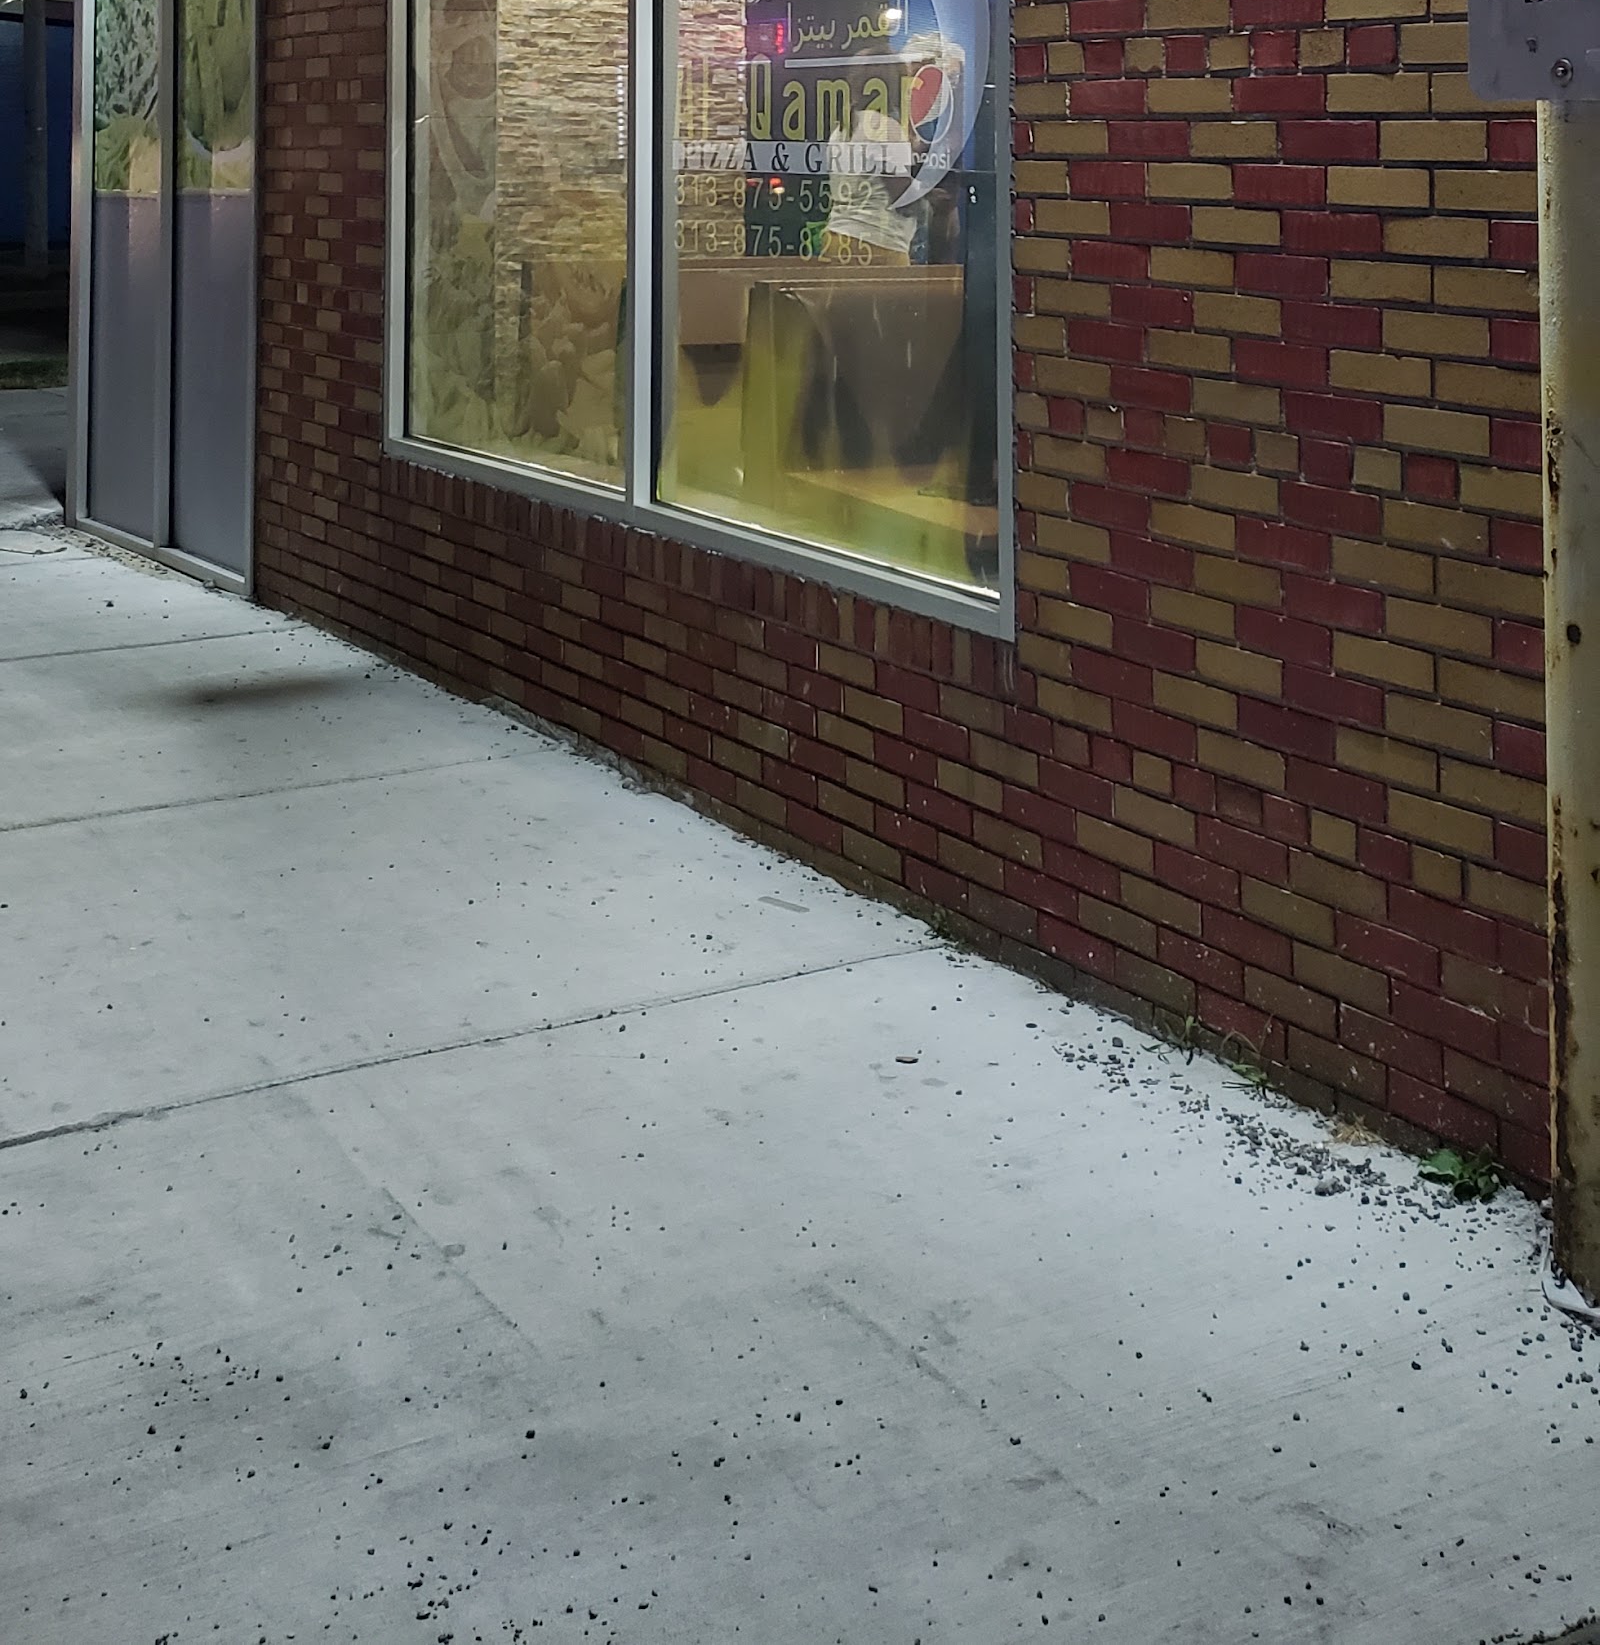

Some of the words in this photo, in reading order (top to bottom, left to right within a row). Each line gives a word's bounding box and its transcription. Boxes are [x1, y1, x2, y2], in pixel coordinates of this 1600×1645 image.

[750, 53, 924, 143] Qamar
[682, 141, 758, 172] PIZZA
[771, 142, 791, 173] &
[804, 143, 898, 175] GRILL
[674, 173, 873, 214] 313-875-5592
[674, 218, 873, 266] 313-875-8285
